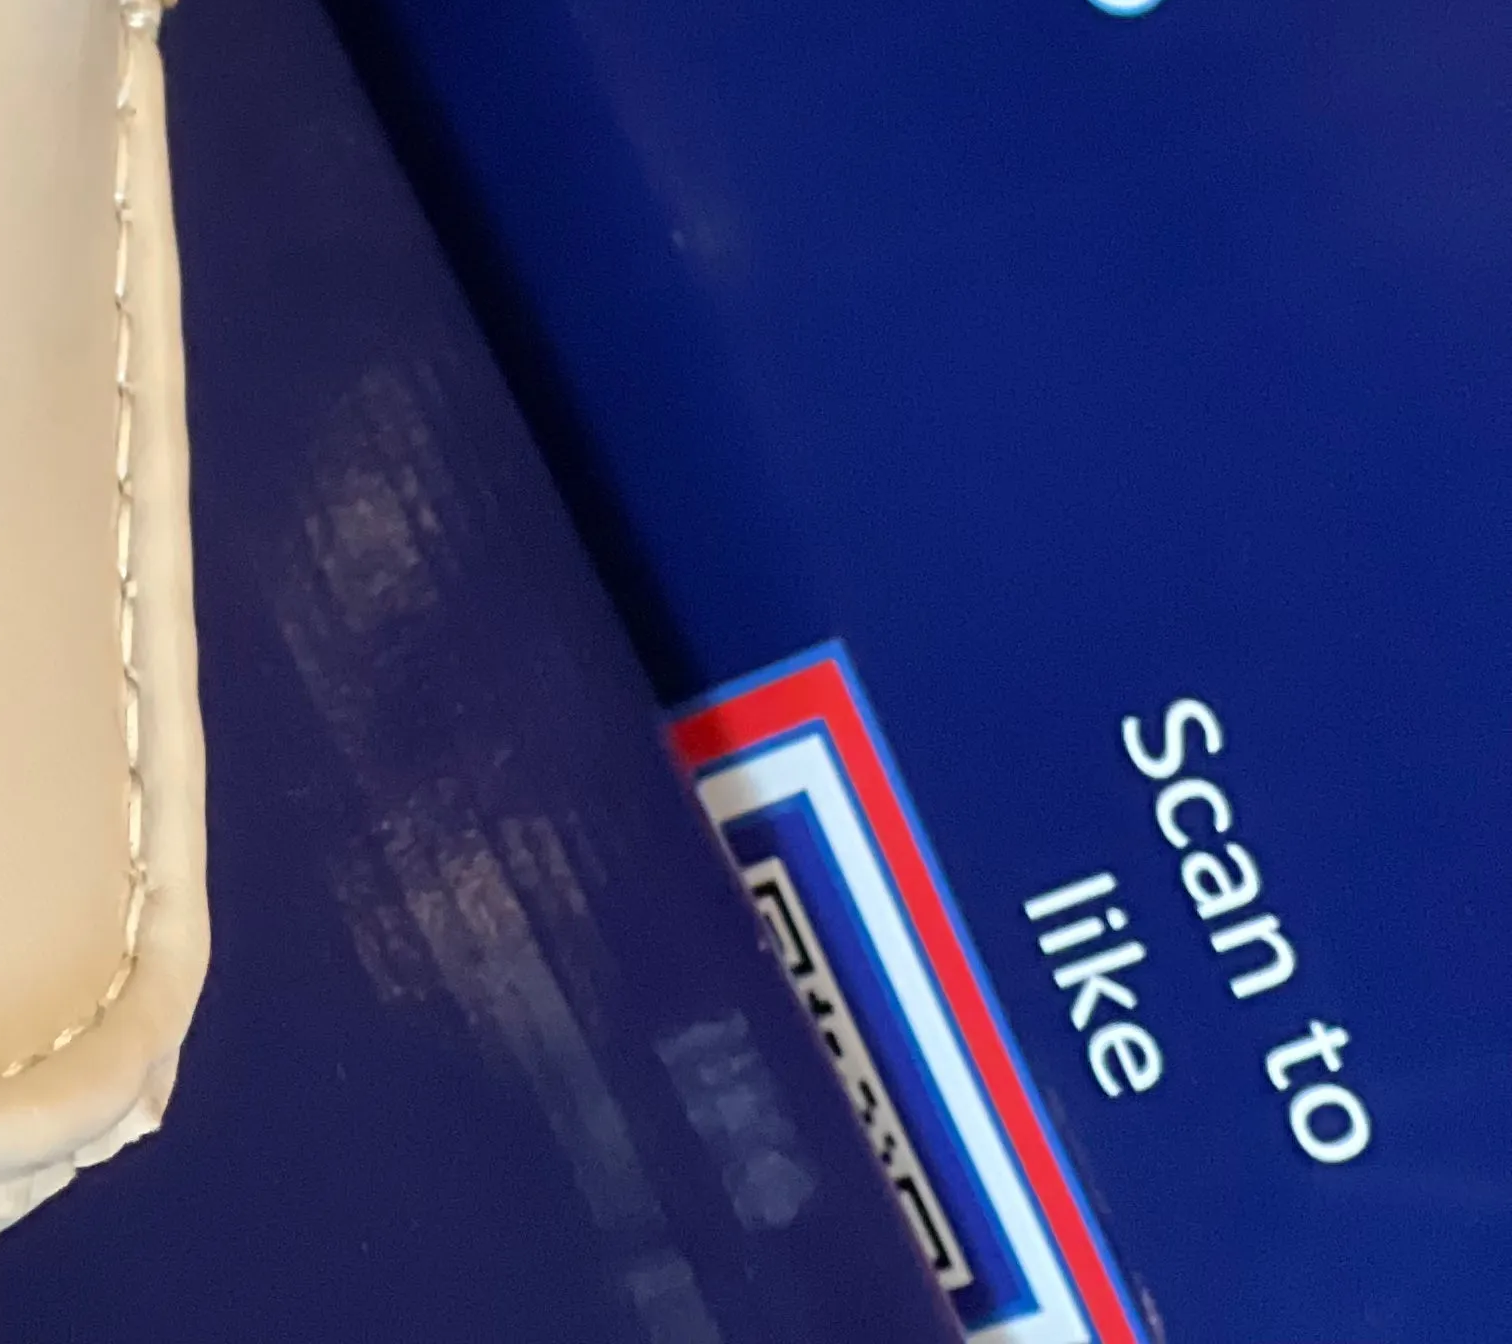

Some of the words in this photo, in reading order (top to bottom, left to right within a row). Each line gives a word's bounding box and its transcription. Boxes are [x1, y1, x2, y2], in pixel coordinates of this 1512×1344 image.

[1022, 870, 1164, 1099] like
[1121, 696, 1297, 1001] Scan
[1264, 1018, 1372, 1165] to
